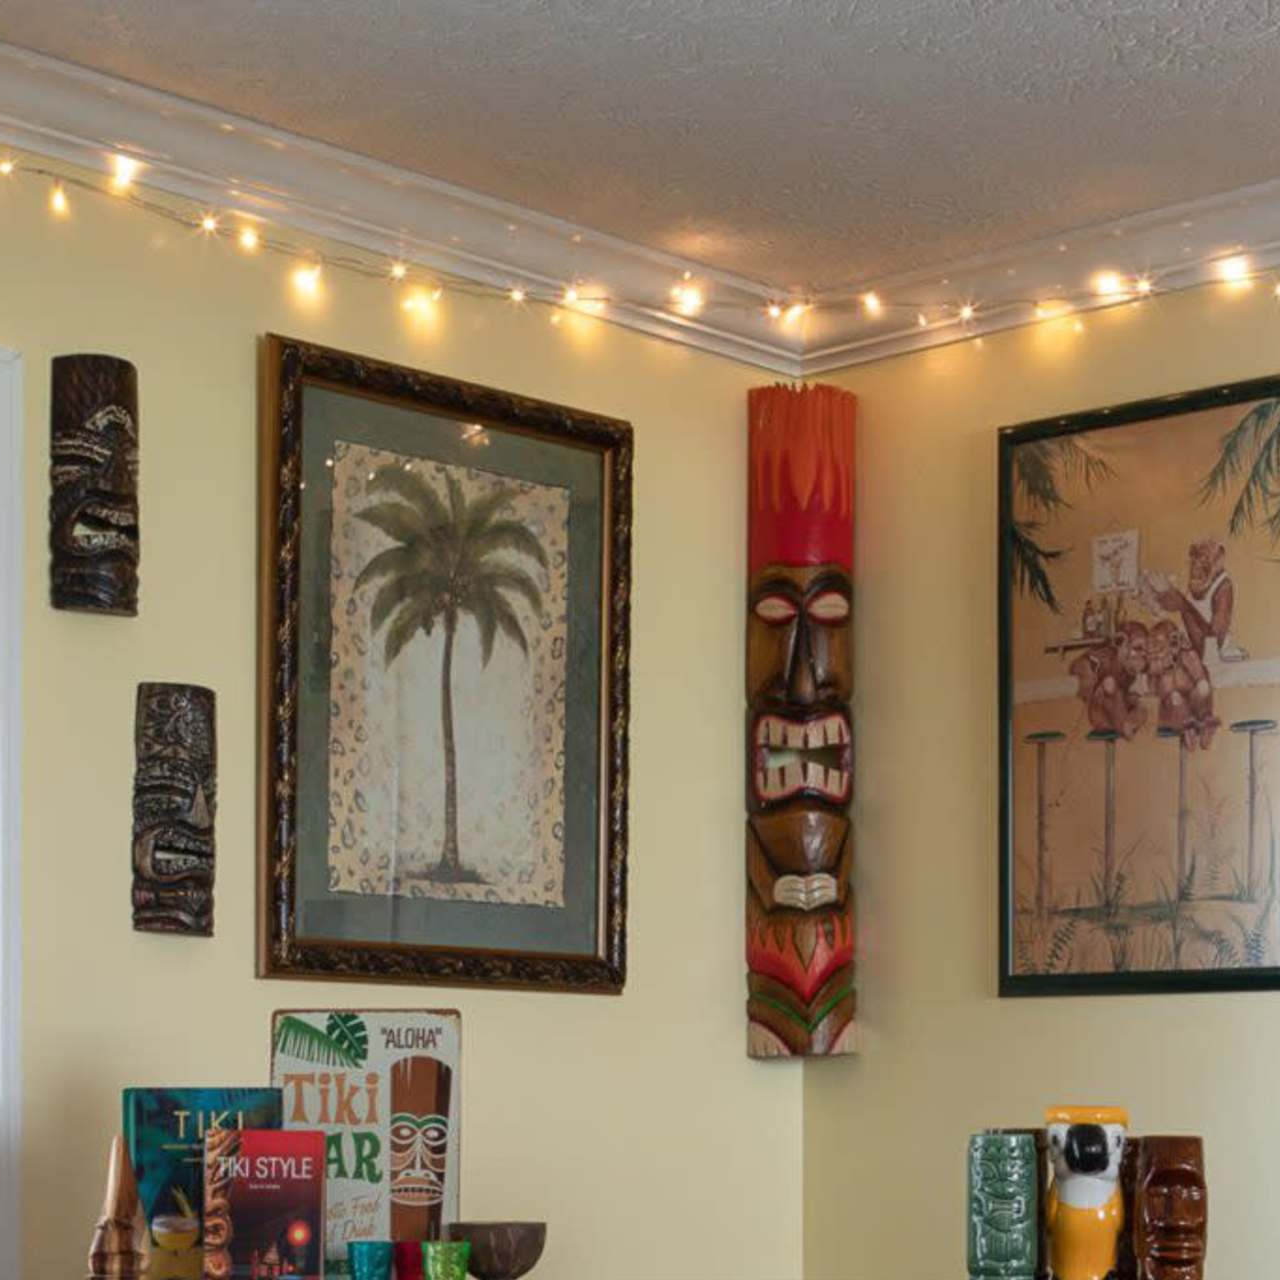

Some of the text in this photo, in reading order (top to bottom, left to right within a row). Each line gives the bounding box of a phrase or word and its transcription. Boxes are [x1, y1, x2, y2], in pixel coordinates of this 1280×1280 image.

[282, 1071, 380, 1126] Tiki
[172, 1110, 244, 1139] TIKI
[216, 1156, 314, 1180] TIKI STYLE
[325, 1130, 384, 1184] AR
